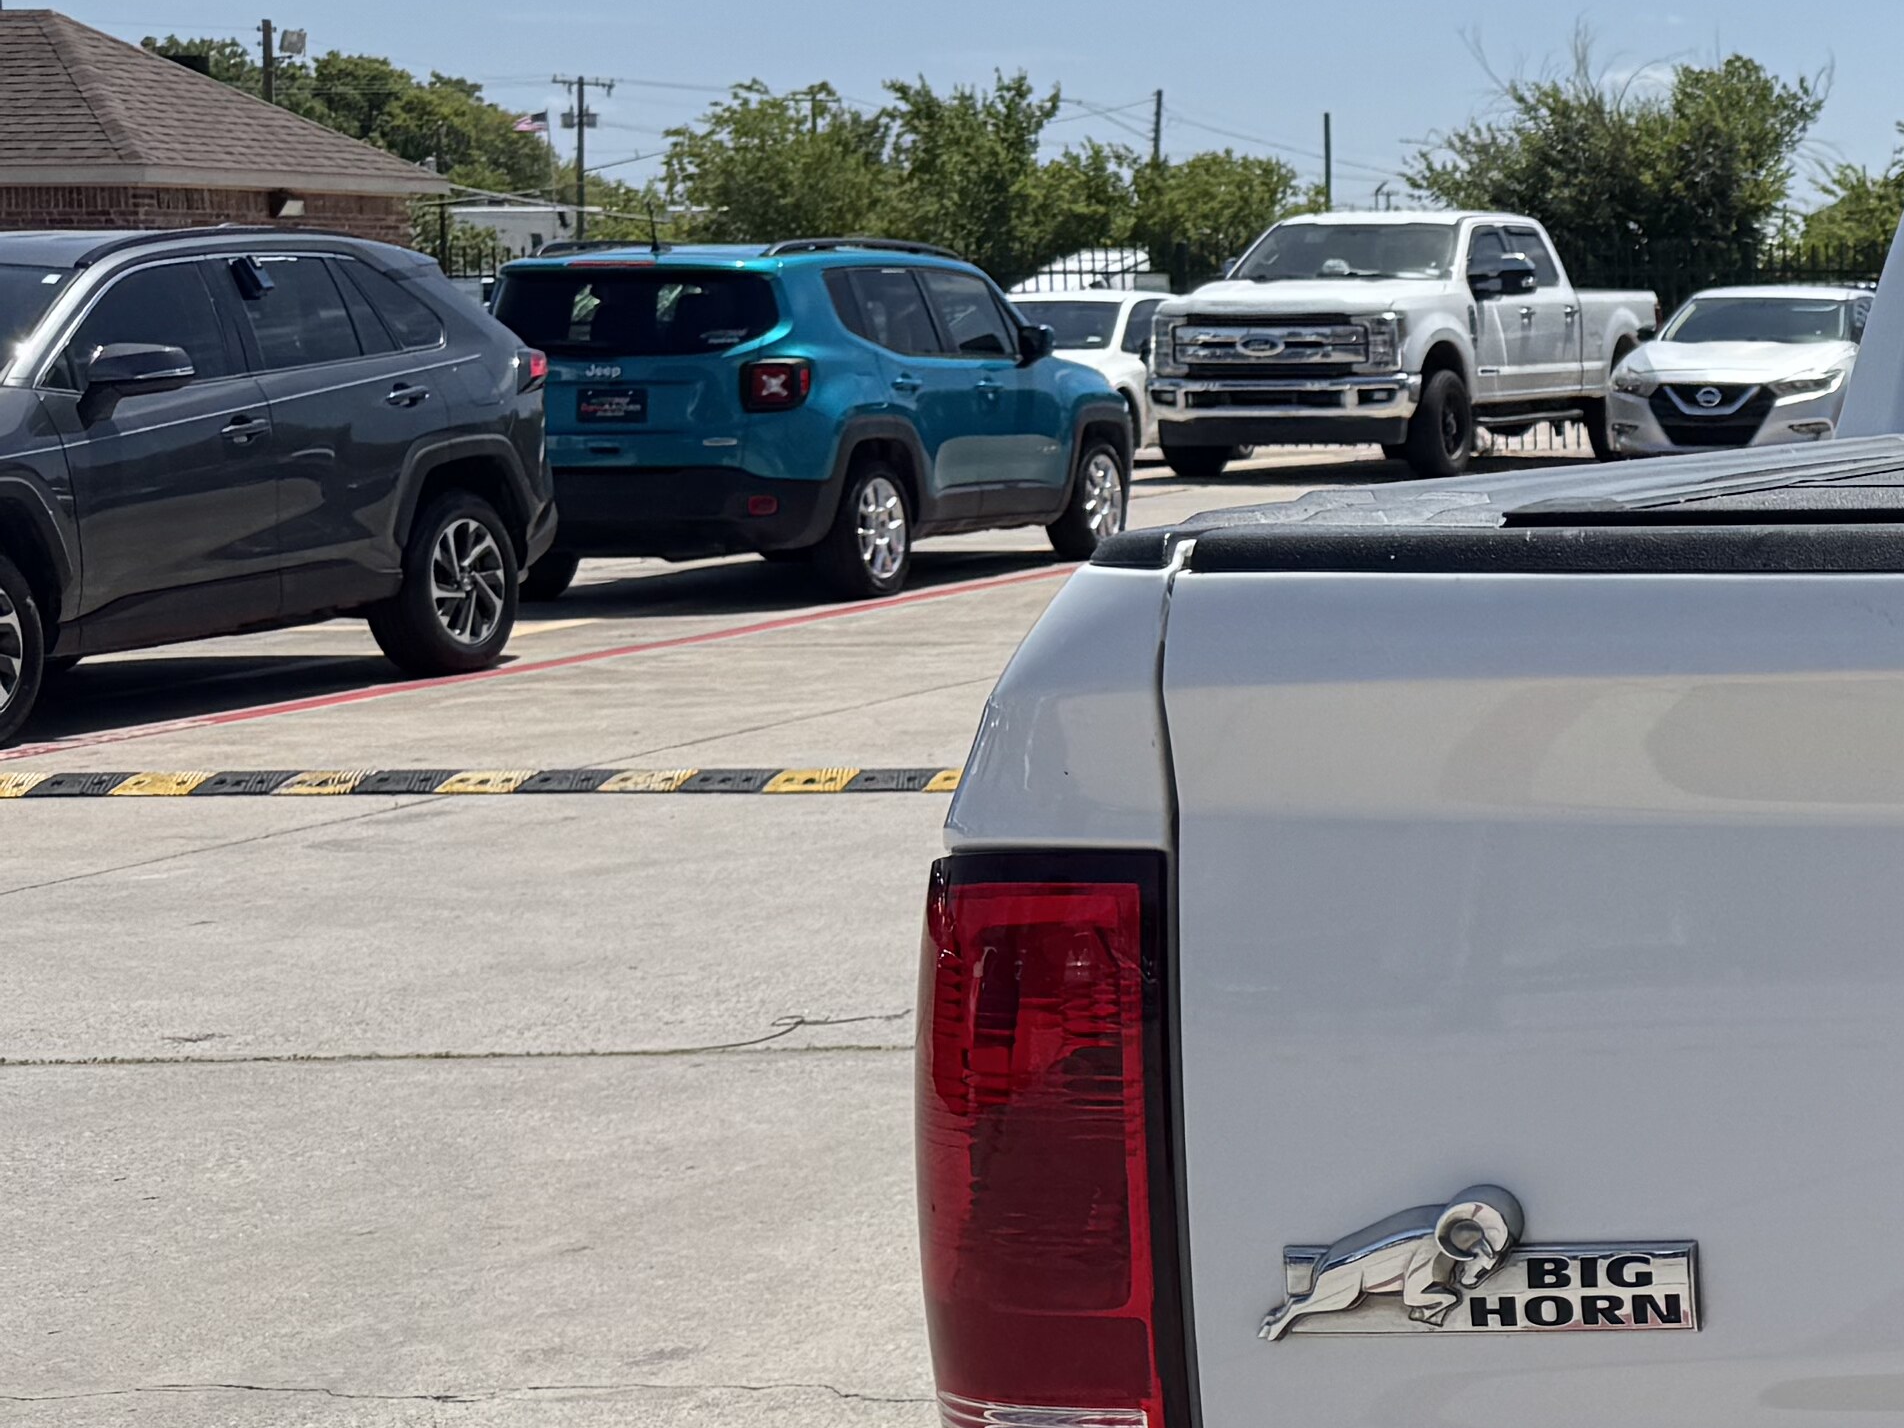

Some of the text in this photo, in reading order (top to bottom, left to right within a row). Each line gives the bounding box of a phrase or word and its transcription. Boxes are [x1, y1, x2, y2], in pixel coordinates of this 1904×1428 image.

[585, 364, 621, 378] Jeep
[1527, 1255, 1654, 1290] BIG
[1470, 1294, 1682, 1328] HORN
